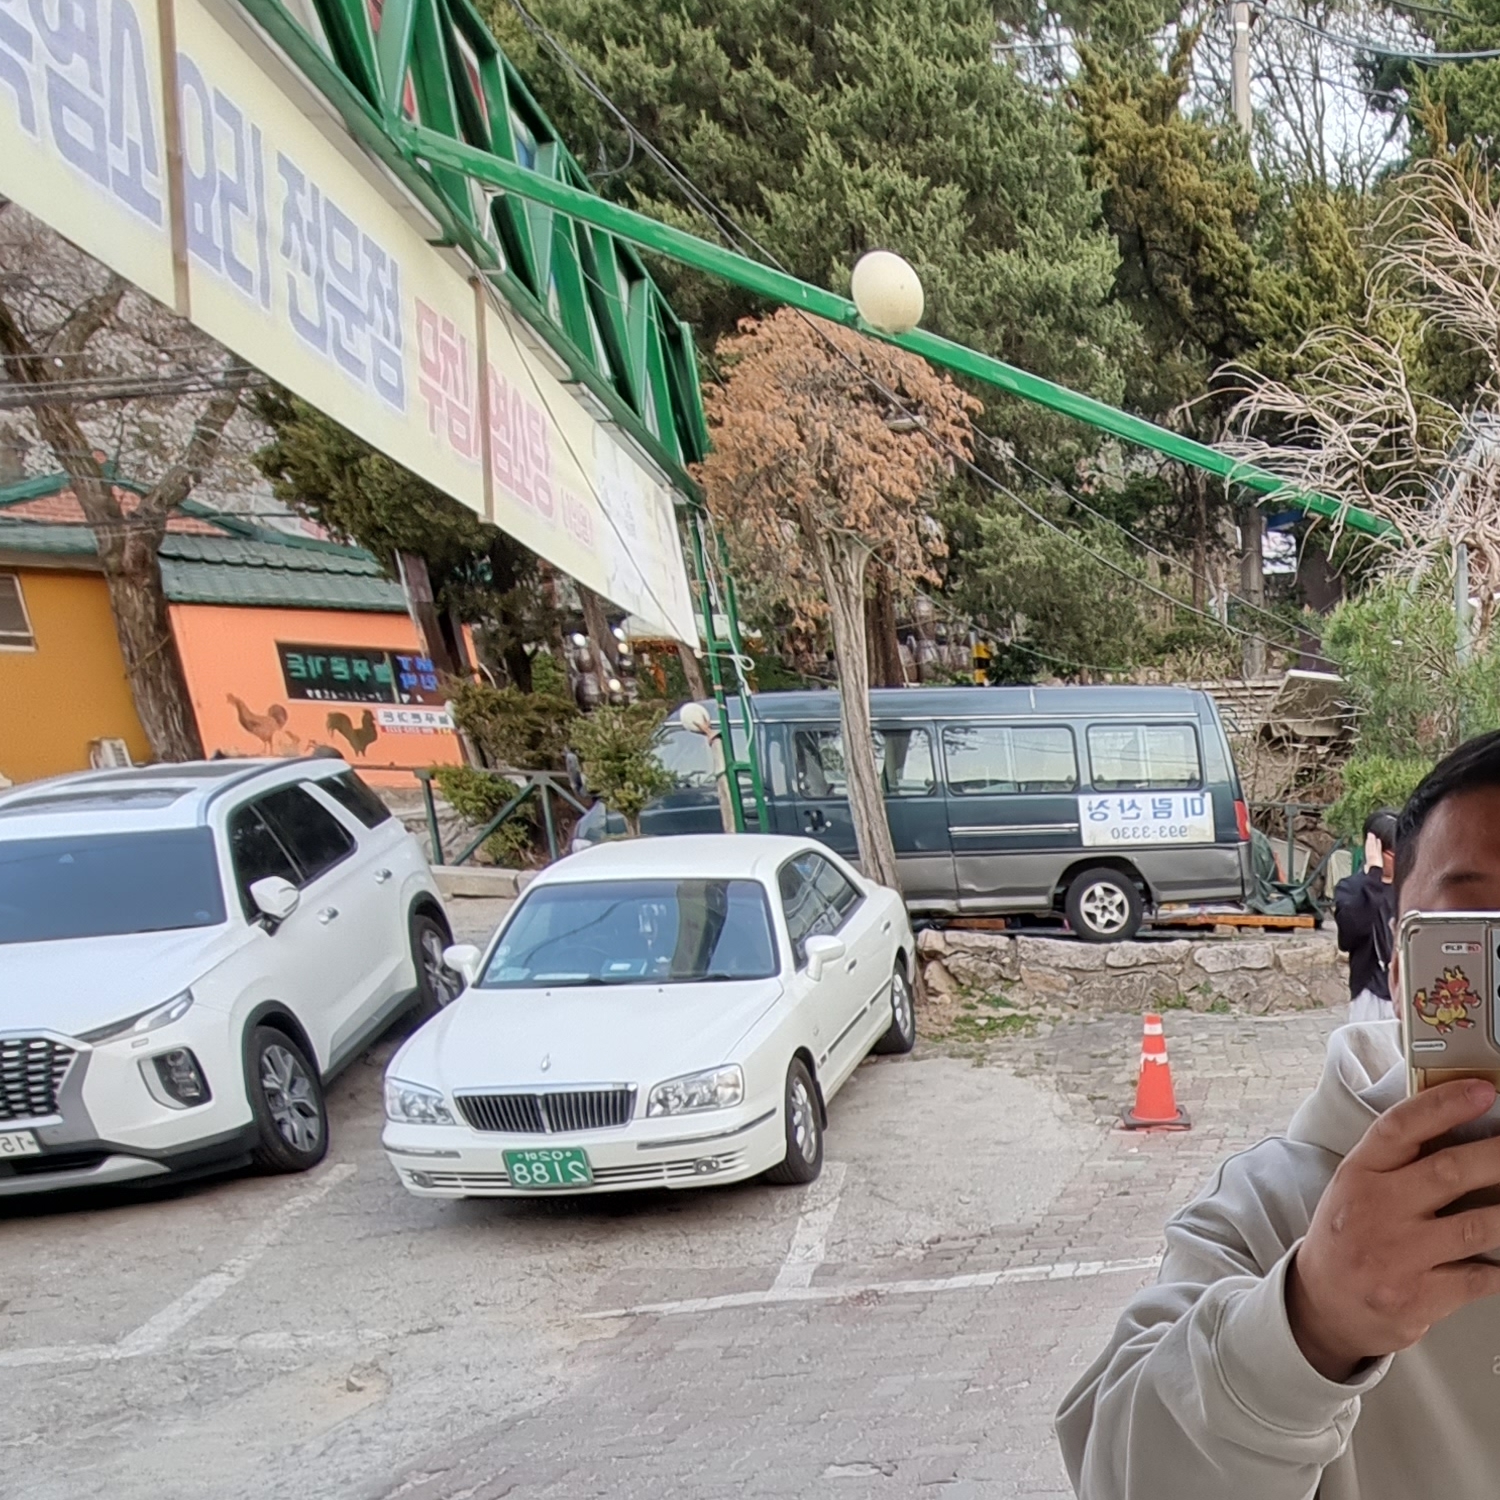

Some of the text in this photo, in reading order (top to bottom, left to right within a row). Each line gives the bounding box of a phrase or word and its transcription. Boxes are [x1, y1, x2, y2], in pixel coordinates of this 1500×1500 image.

[0, 0, 162, 228] 염소
[176, 51, 271, 312] 요리
[277, 149, 406, 412] 전문점
